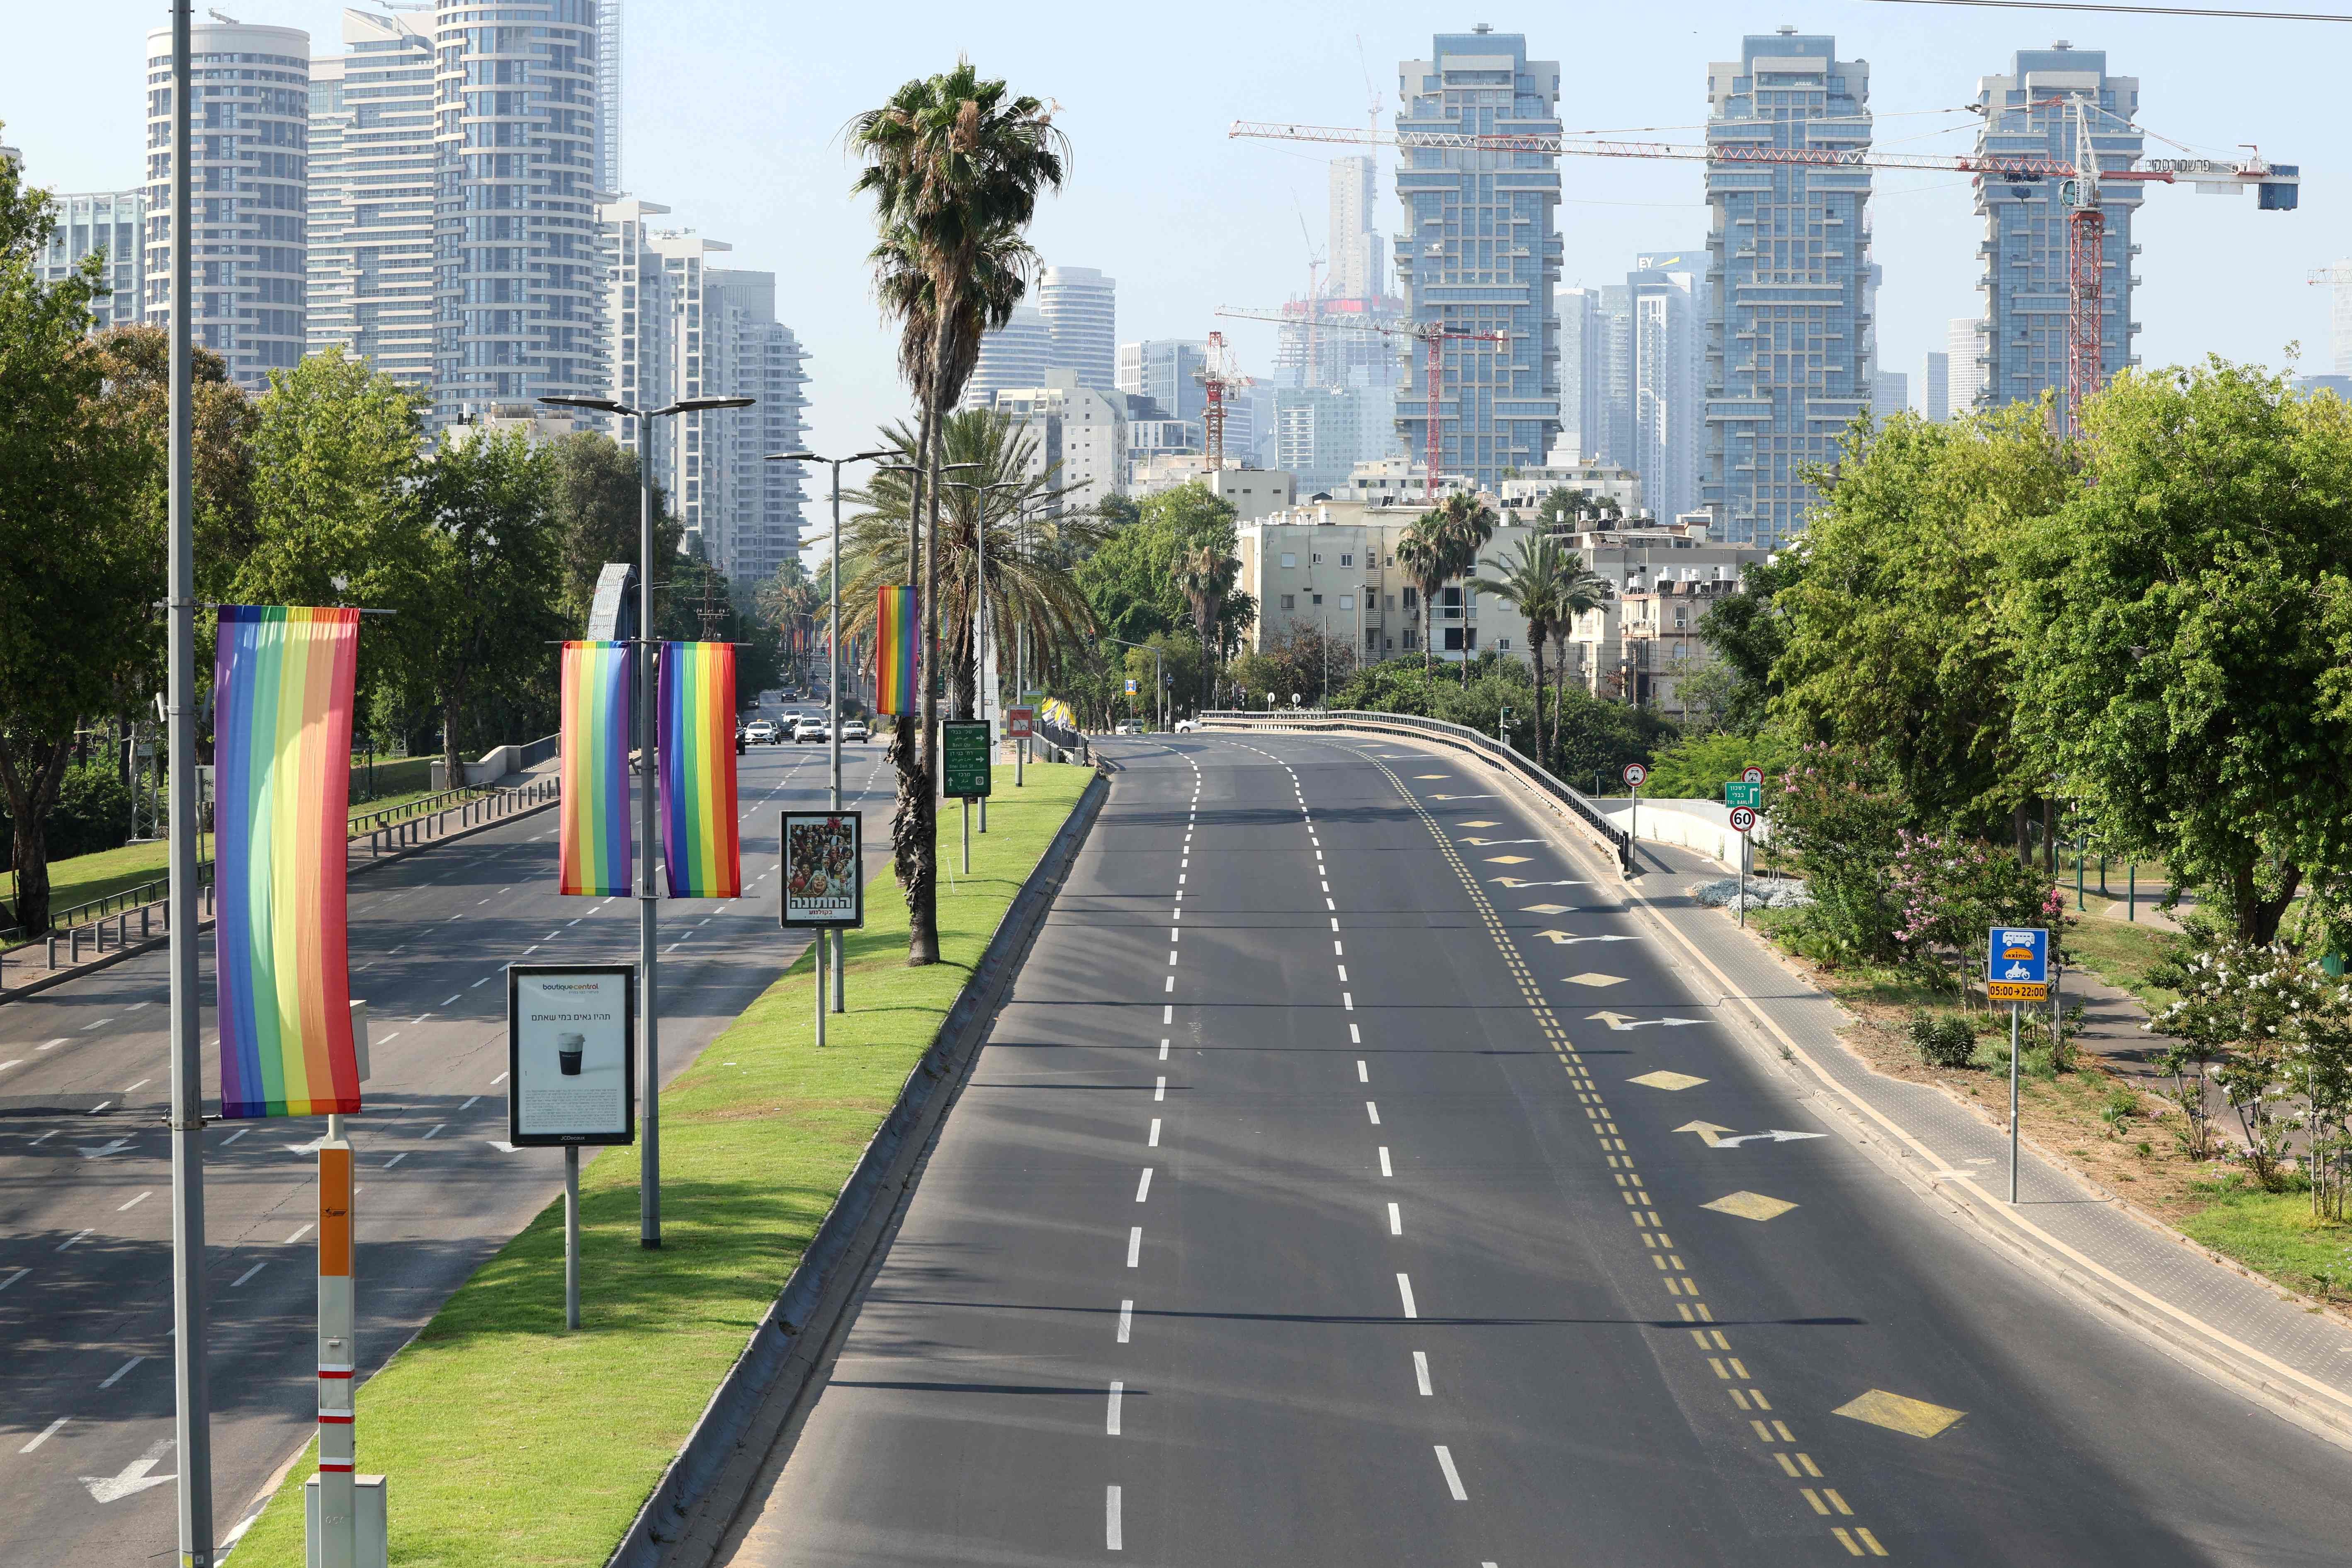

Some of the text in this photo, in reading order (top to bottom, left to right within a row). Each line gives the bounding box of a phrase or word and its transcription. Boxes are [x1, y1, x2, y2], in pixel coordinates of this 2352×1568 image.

[1639, 257, 1654, 269] EY
[1734, 813, 1751, 825] 60
[791, 897, 850, 908] החתונה
[1990, 986, 2044, 997] 05:00 22:00
